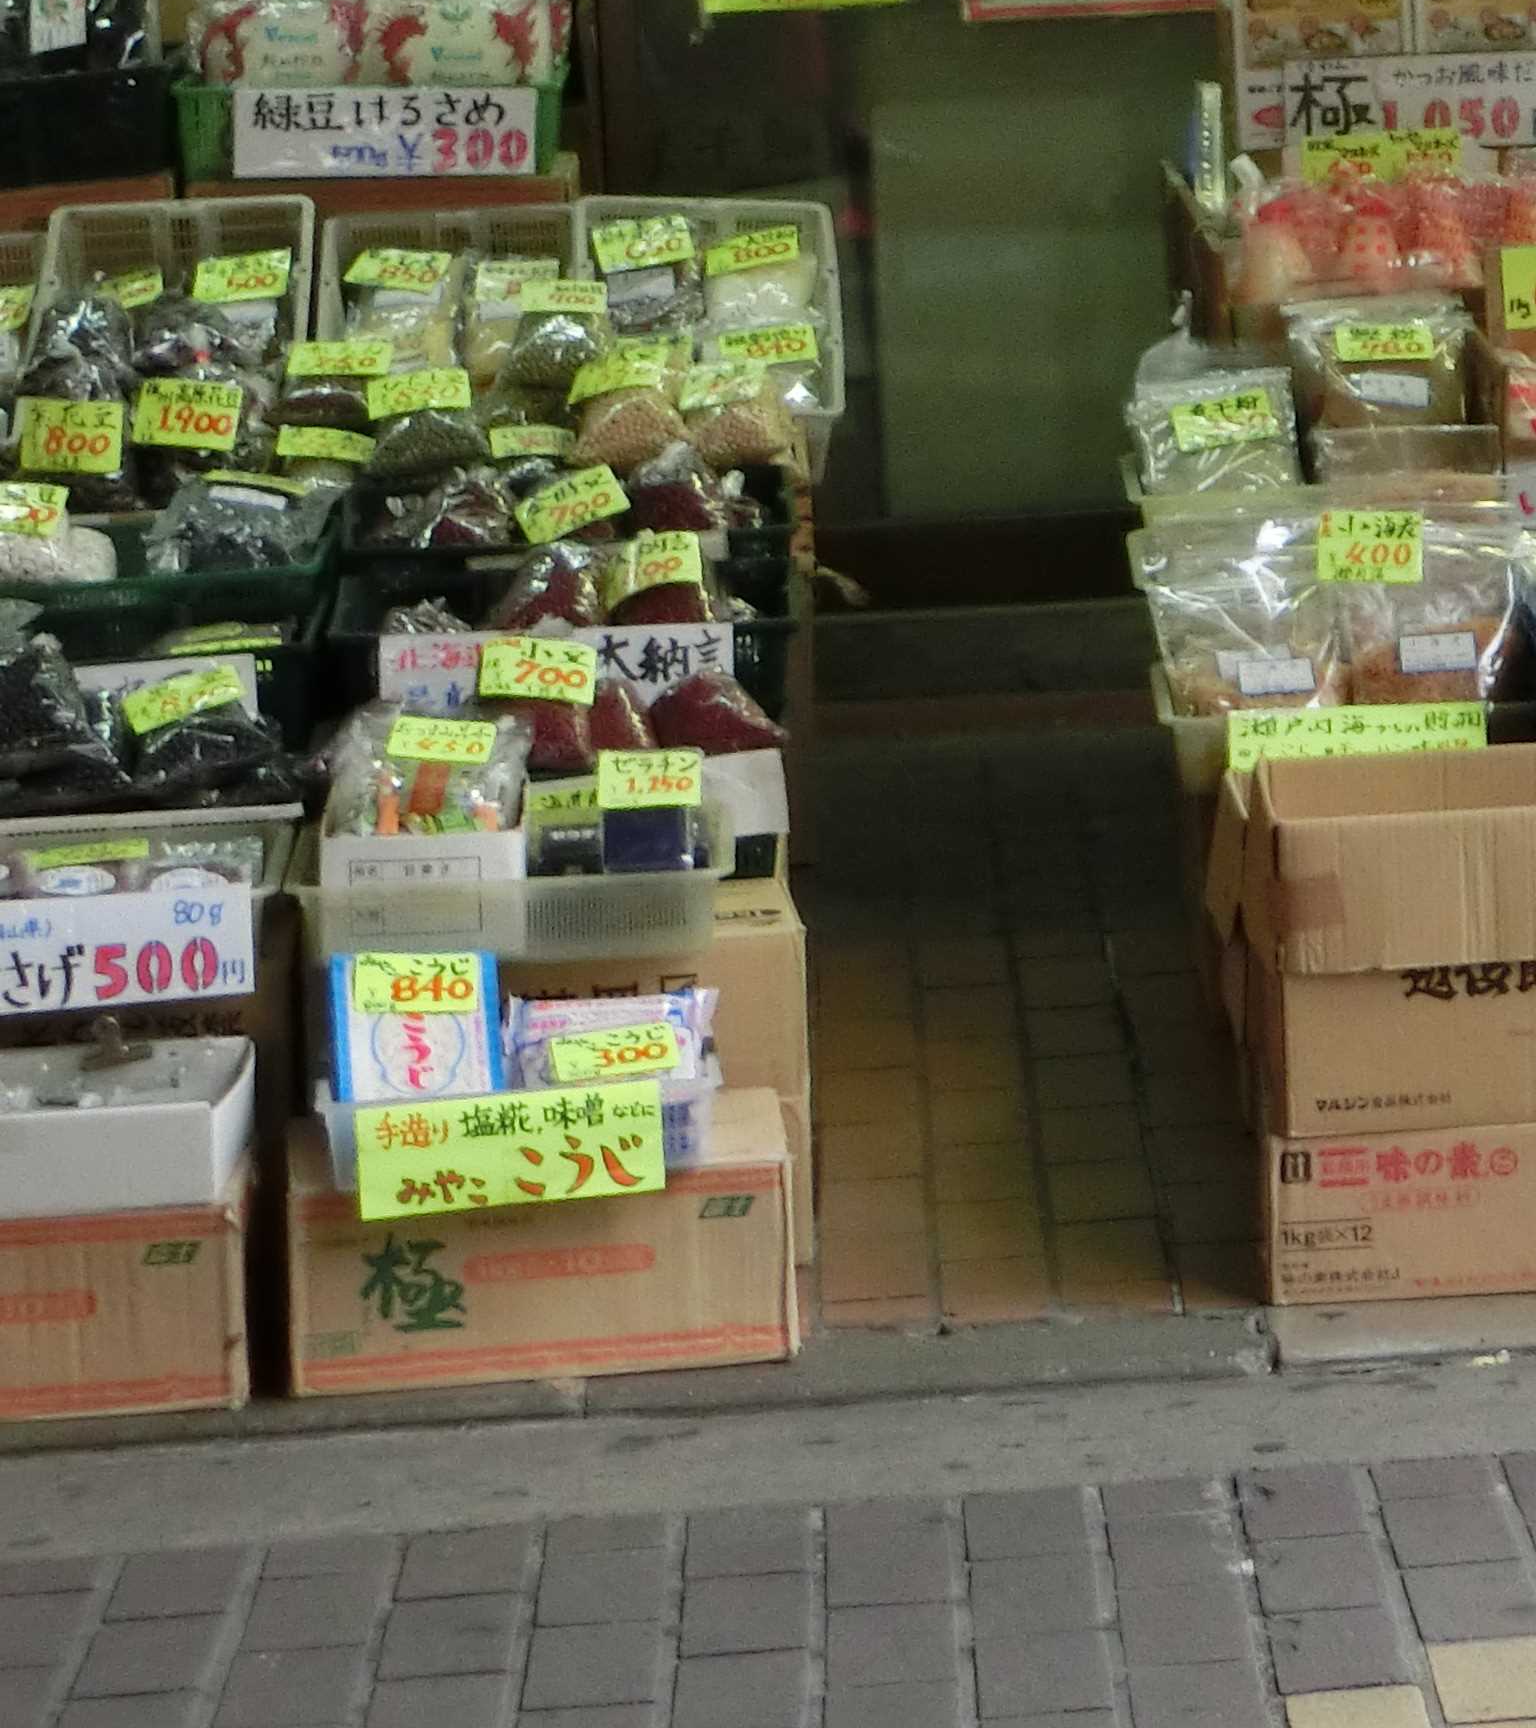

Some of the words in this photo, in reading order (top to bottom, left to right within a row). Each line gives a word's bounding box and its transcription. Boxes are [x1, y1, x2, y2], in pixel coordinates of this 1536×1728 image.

[253, 91, 505, 132] 緑豆はるさめ
[1289, 71, 1377, 137] 極
[44, 424, 112, 456] 800
[511, 657, 589, 689] 700
[599, 632, 723, 687] 大納言
[389, 976, 474, 1006] 840
[593, 1042, 669, 1069] 300
[375, 1114, 450, 1150] 手造り
[396, 1167, 489, 1208] みやこ
[515, 1132, 645, 1196] こうじ
[361, 1235, 469, 1335] 極
